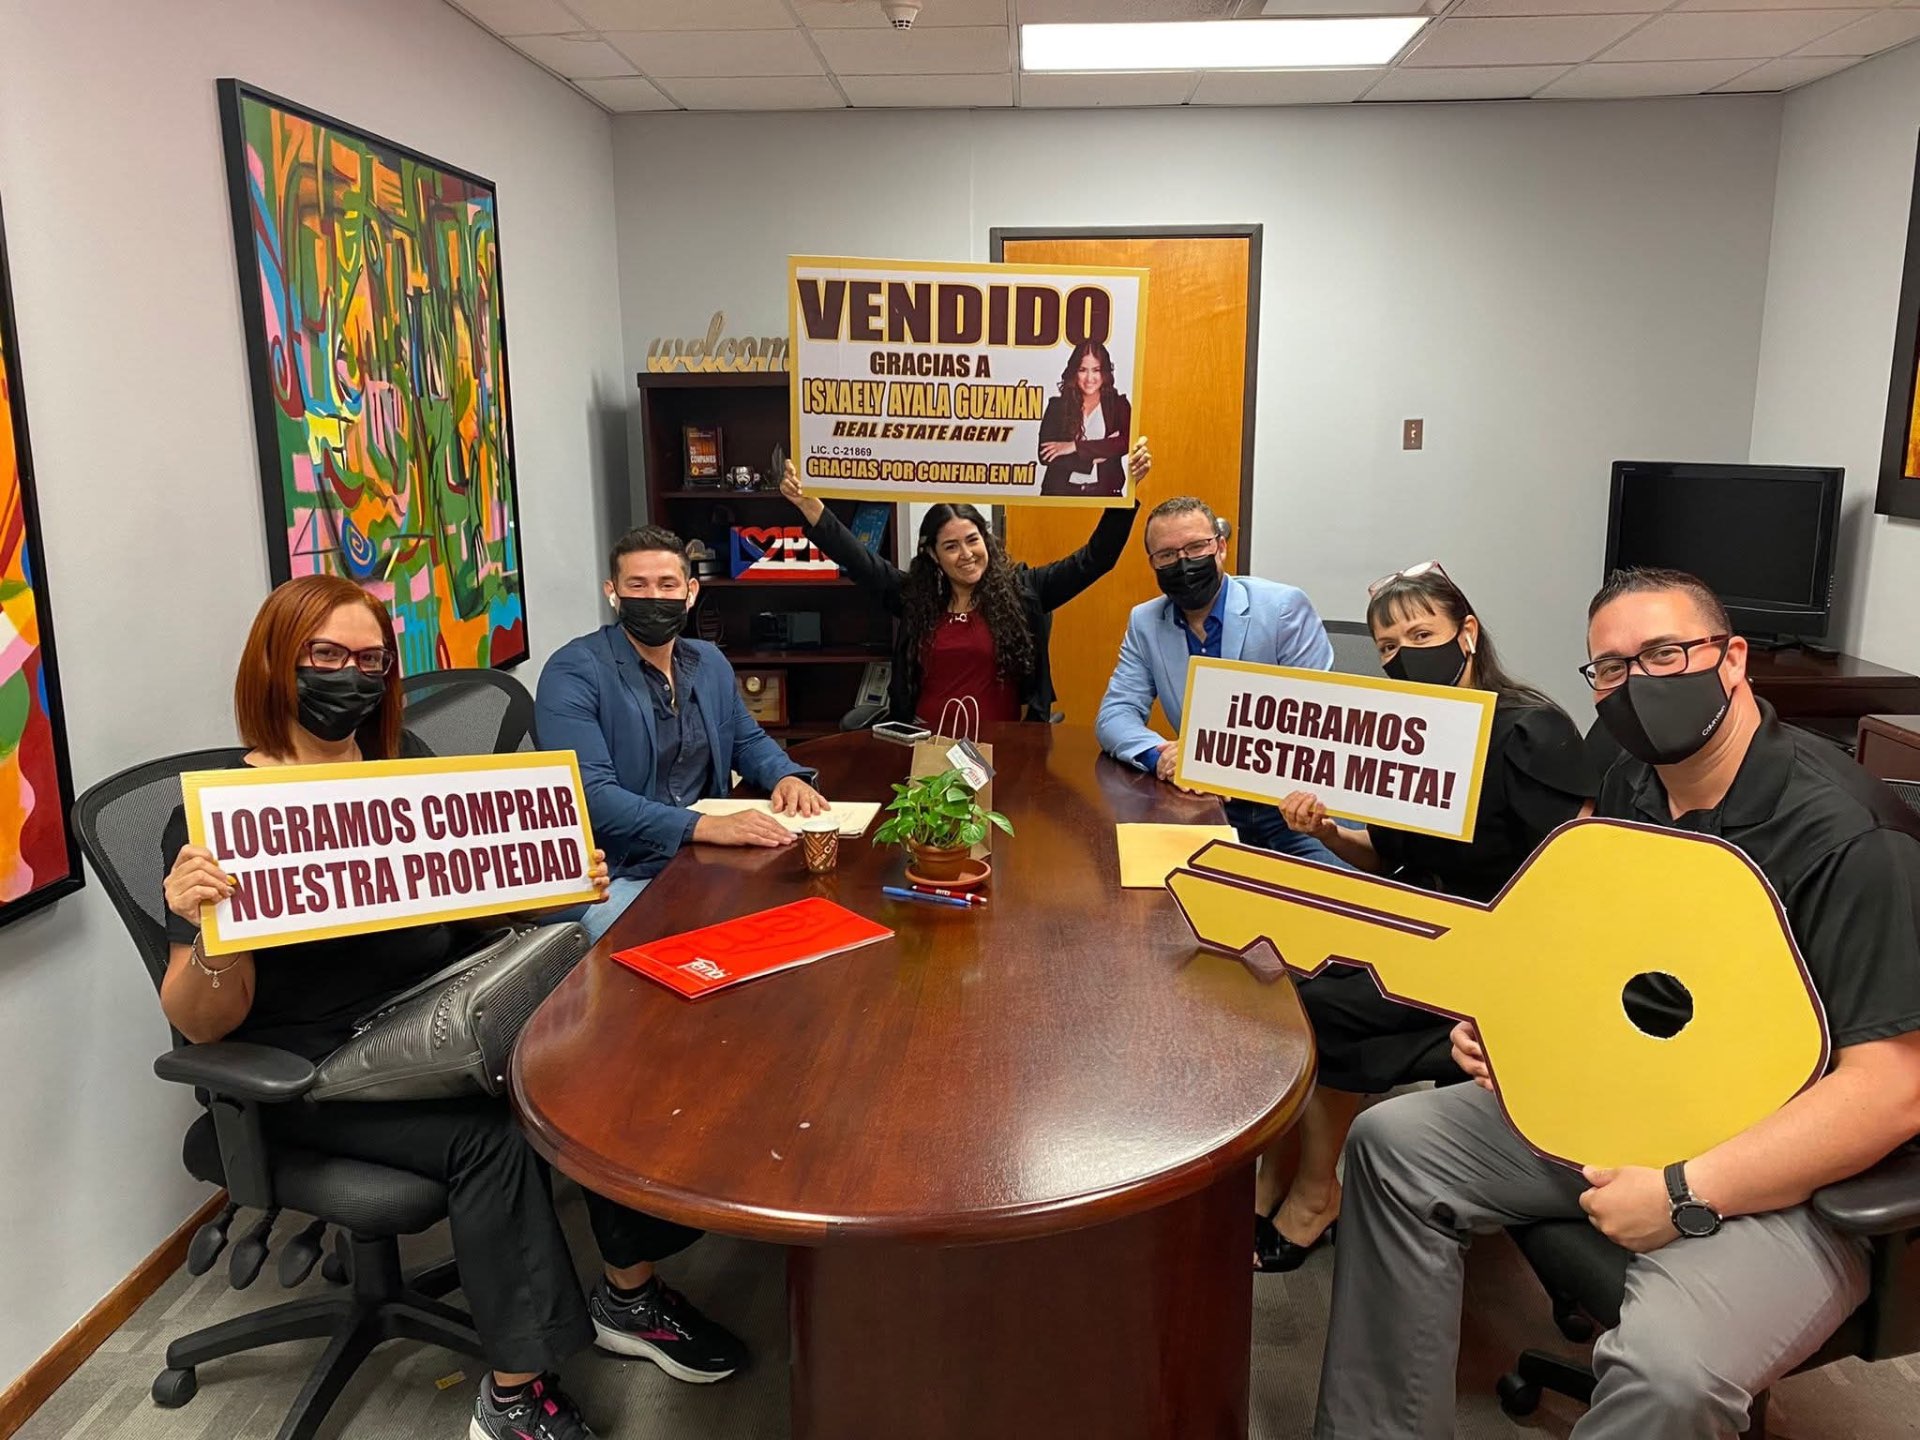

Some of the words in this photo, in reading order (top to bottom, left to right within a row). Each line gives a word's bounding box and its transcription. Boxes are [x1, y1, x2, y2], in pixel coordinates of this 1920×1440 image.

[646, 310, 789, 372] welcom
[796, 278, 1113, 347] VENDIDO
[870, 351, 970, 378] GRACIAS
[975, 354, 991, 379] A
[803, 378, 885, 416] ISXAELY
[887, 381, 952, 420] AYALA
[954, 379, 1043, 421] GUZMÁN
[810, 445, 830, 456] LIC.
[832, 446, 872, 458] C-21869
[832, 421, 880, 438] REAL
[881, 422, 948, 441] ESTATE
[950, 425, 1014, 443] AGENT
[806, 456, 879, 480] GRACIAS
[881, 459, 913, 481] POR
[917, 461, 987, 484] CONFIAR
[989, 463, 1010, 484] EN
[1011, 462, 1037, 486] MÍ
[1226, 692, 1428, 756] ¡LOGRAMOS
[1194, 728, 1336, 788] NUESTRA
[1343, 754, 1457, 810] META!
[210, 797, 416, 861] LOGRAMOS
[421, 785, 578, 839] COMPRAR
[230, 856, 401, 923] NUESTRA
[403, 837, 583, 900] PROPIEDAD
